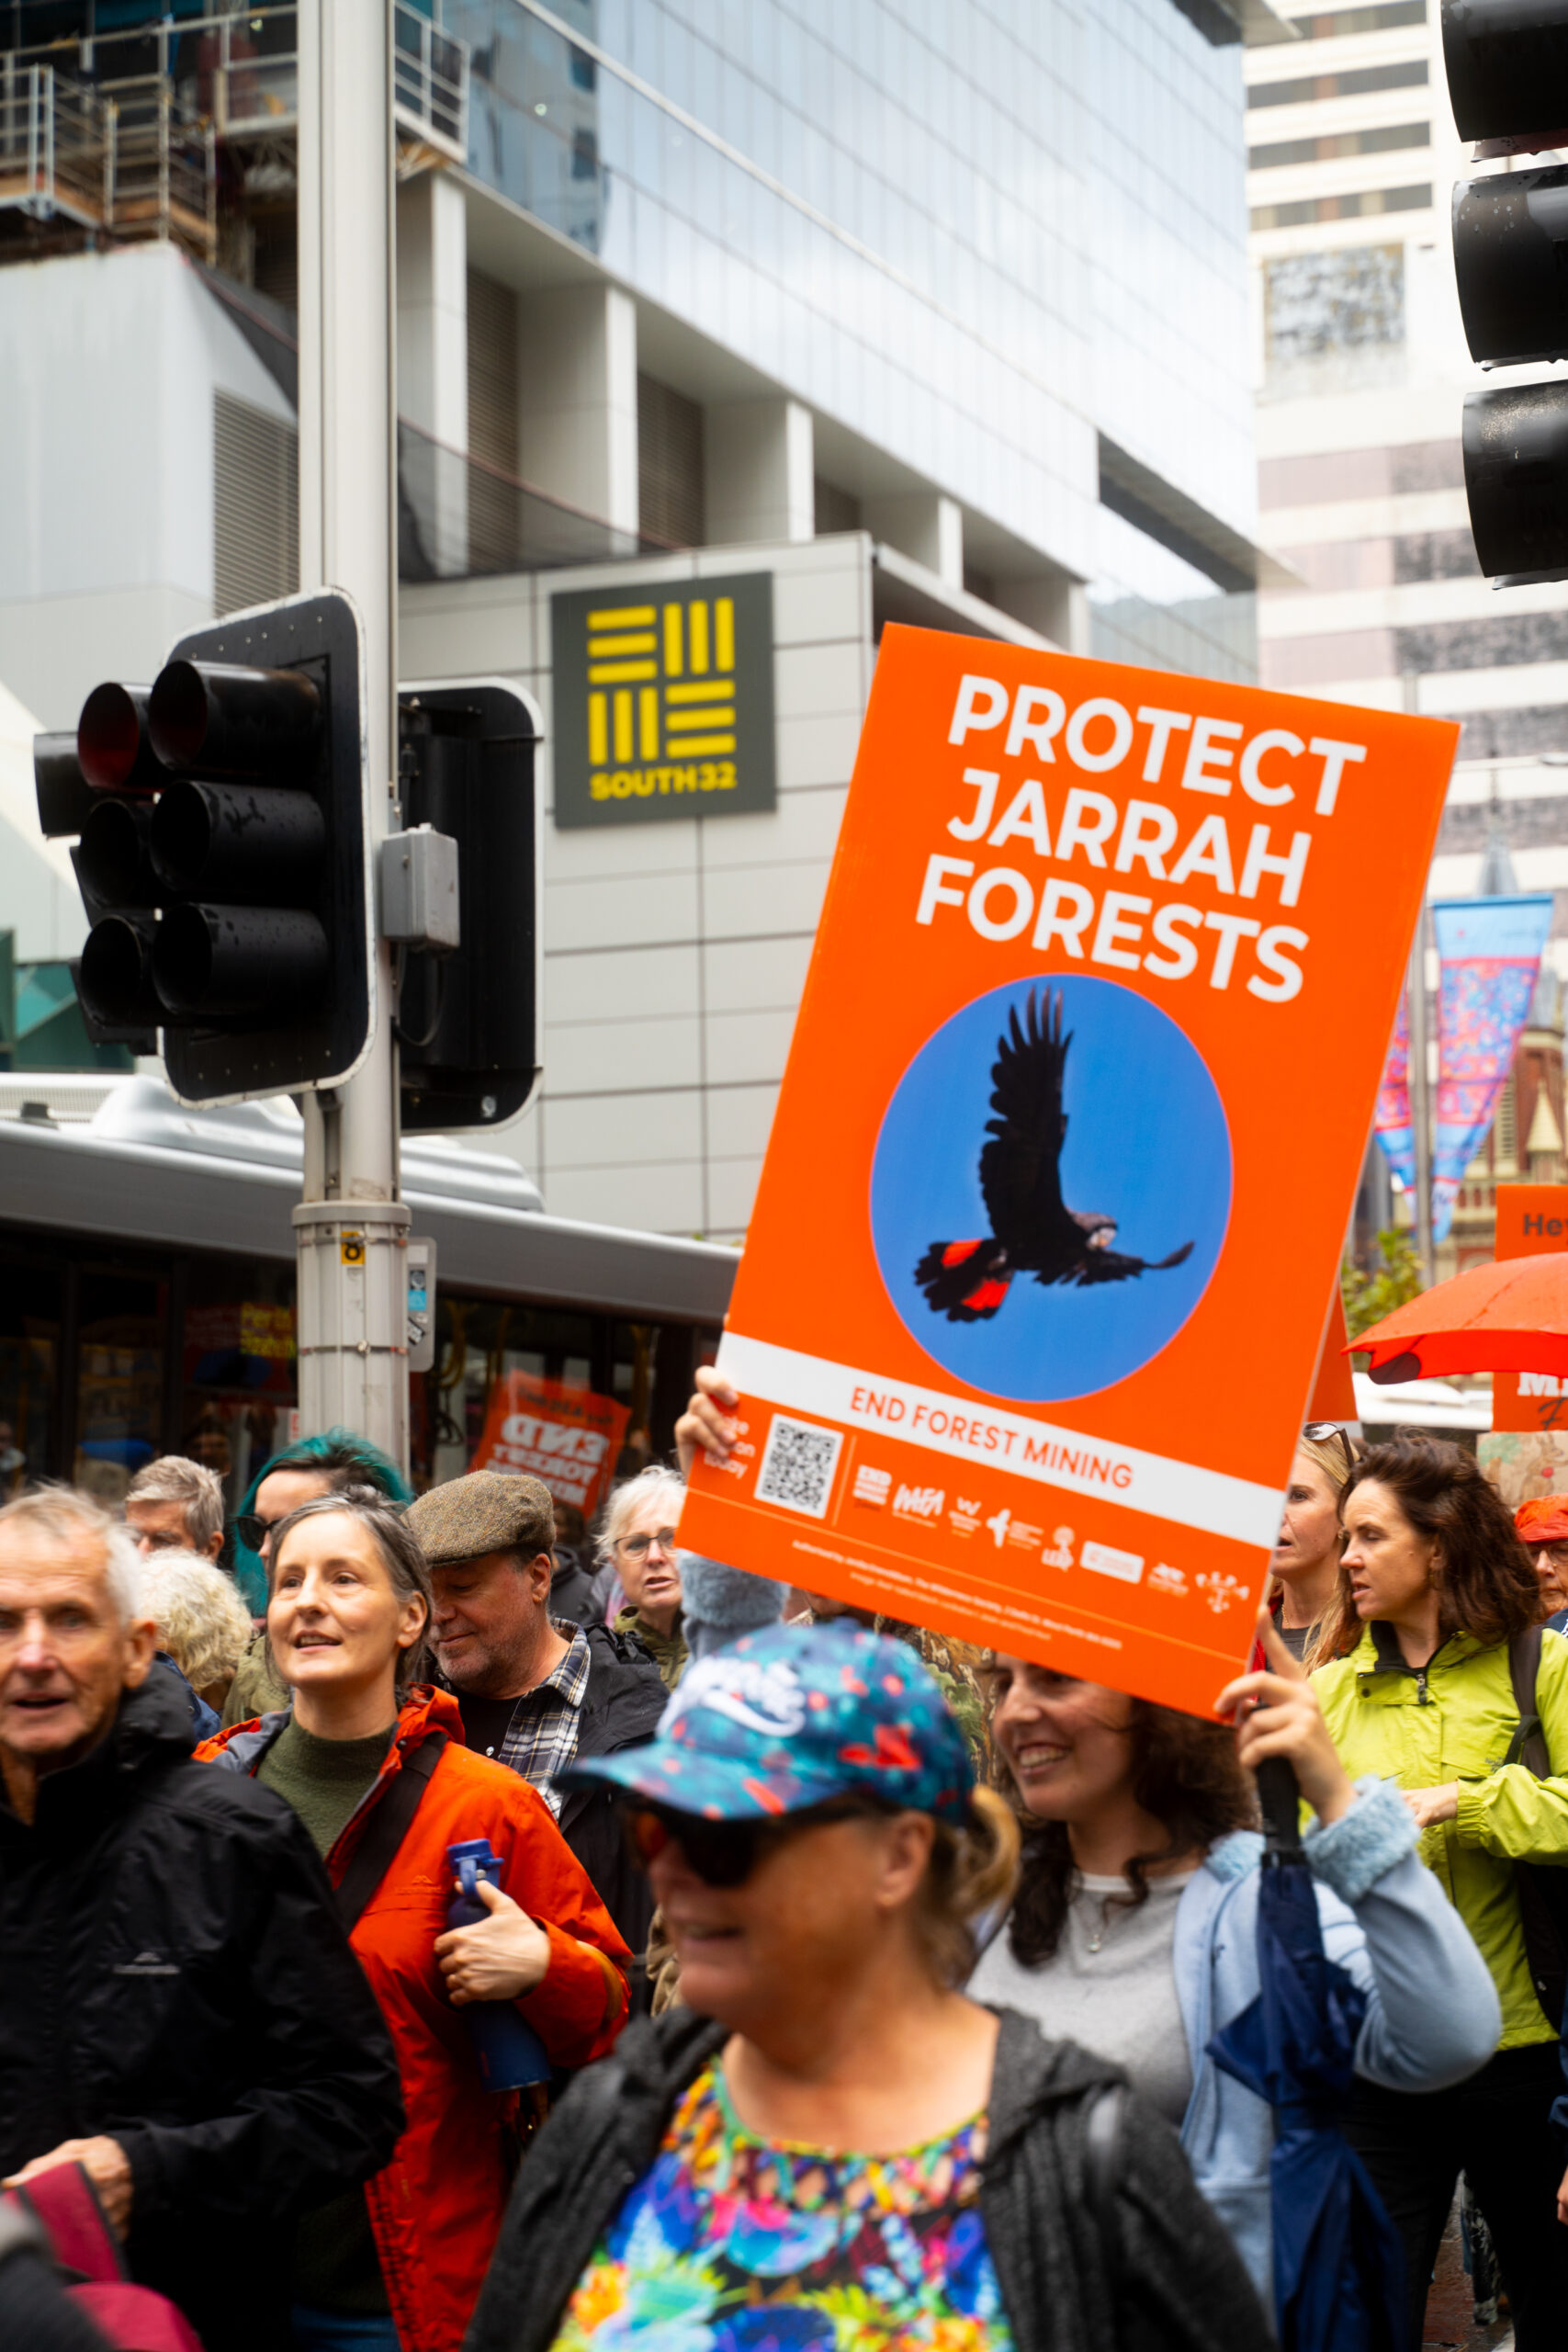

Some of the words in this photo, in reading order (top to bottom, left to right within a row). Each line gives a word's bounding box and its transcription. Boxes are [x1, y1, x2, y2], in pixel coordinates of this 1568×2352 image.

[590, 761, 738, 801] SOUTH32
[947, 673, 1367, 817] PROTECT
[946, 766, 1313, 908] JARRAH
[915, 853, 1310, 1003] FORESTS
[850, 1386, 907, 1422] END
[911, 1405, 1020, 1456] FOREST
[1022, 1436, 1134, 1489] MINING
